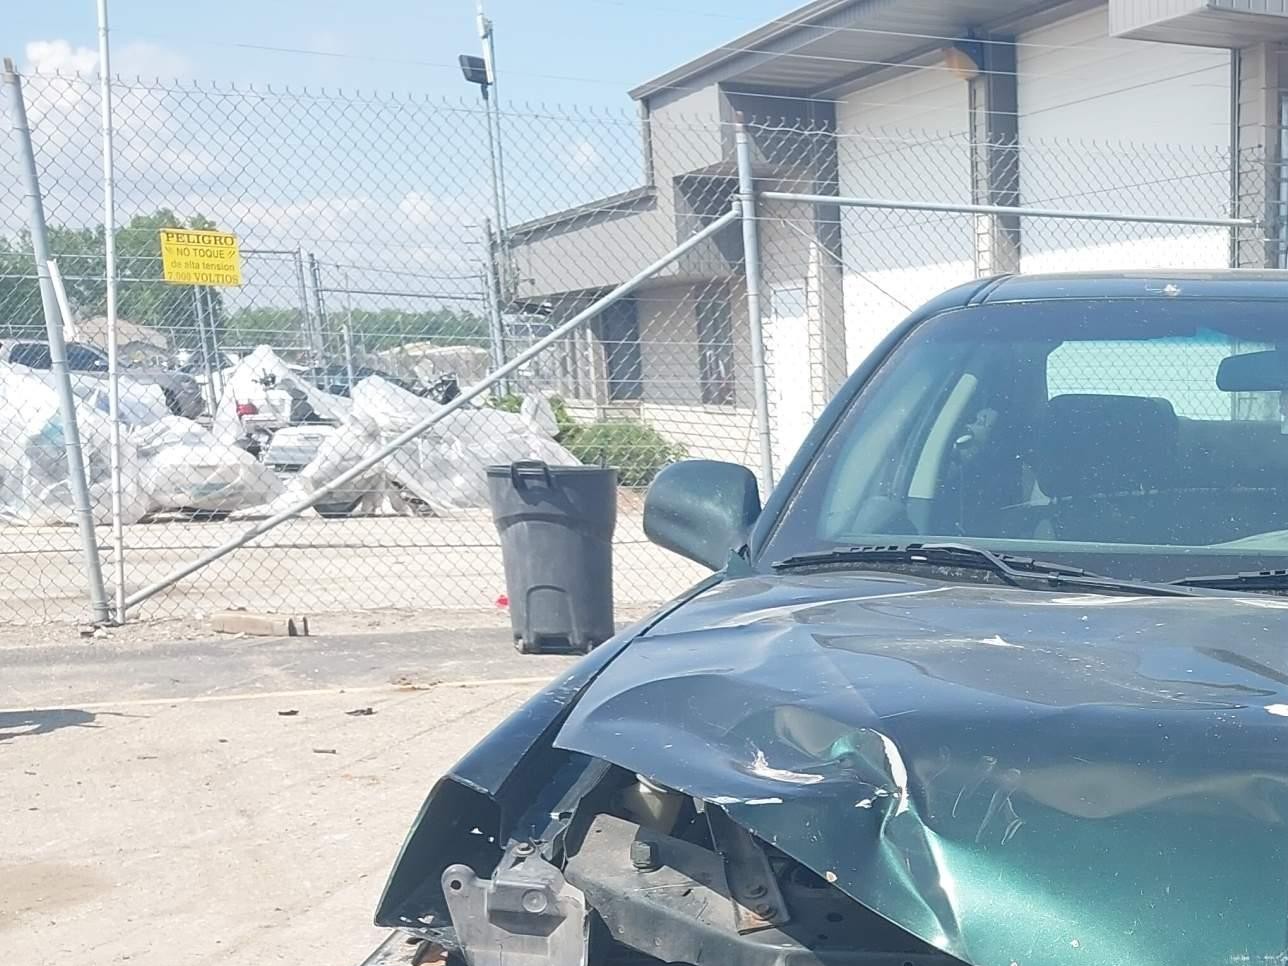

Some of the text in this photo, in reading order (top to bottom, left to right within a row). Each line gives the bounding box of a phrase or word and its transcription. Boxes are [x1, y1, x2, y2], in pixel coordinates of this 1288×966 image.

[165, 232, 235, 246] PELIGRO
[176, 247, 225, 259] NO TOQUE
[193, 272, 239, 284] VOLTIOS
